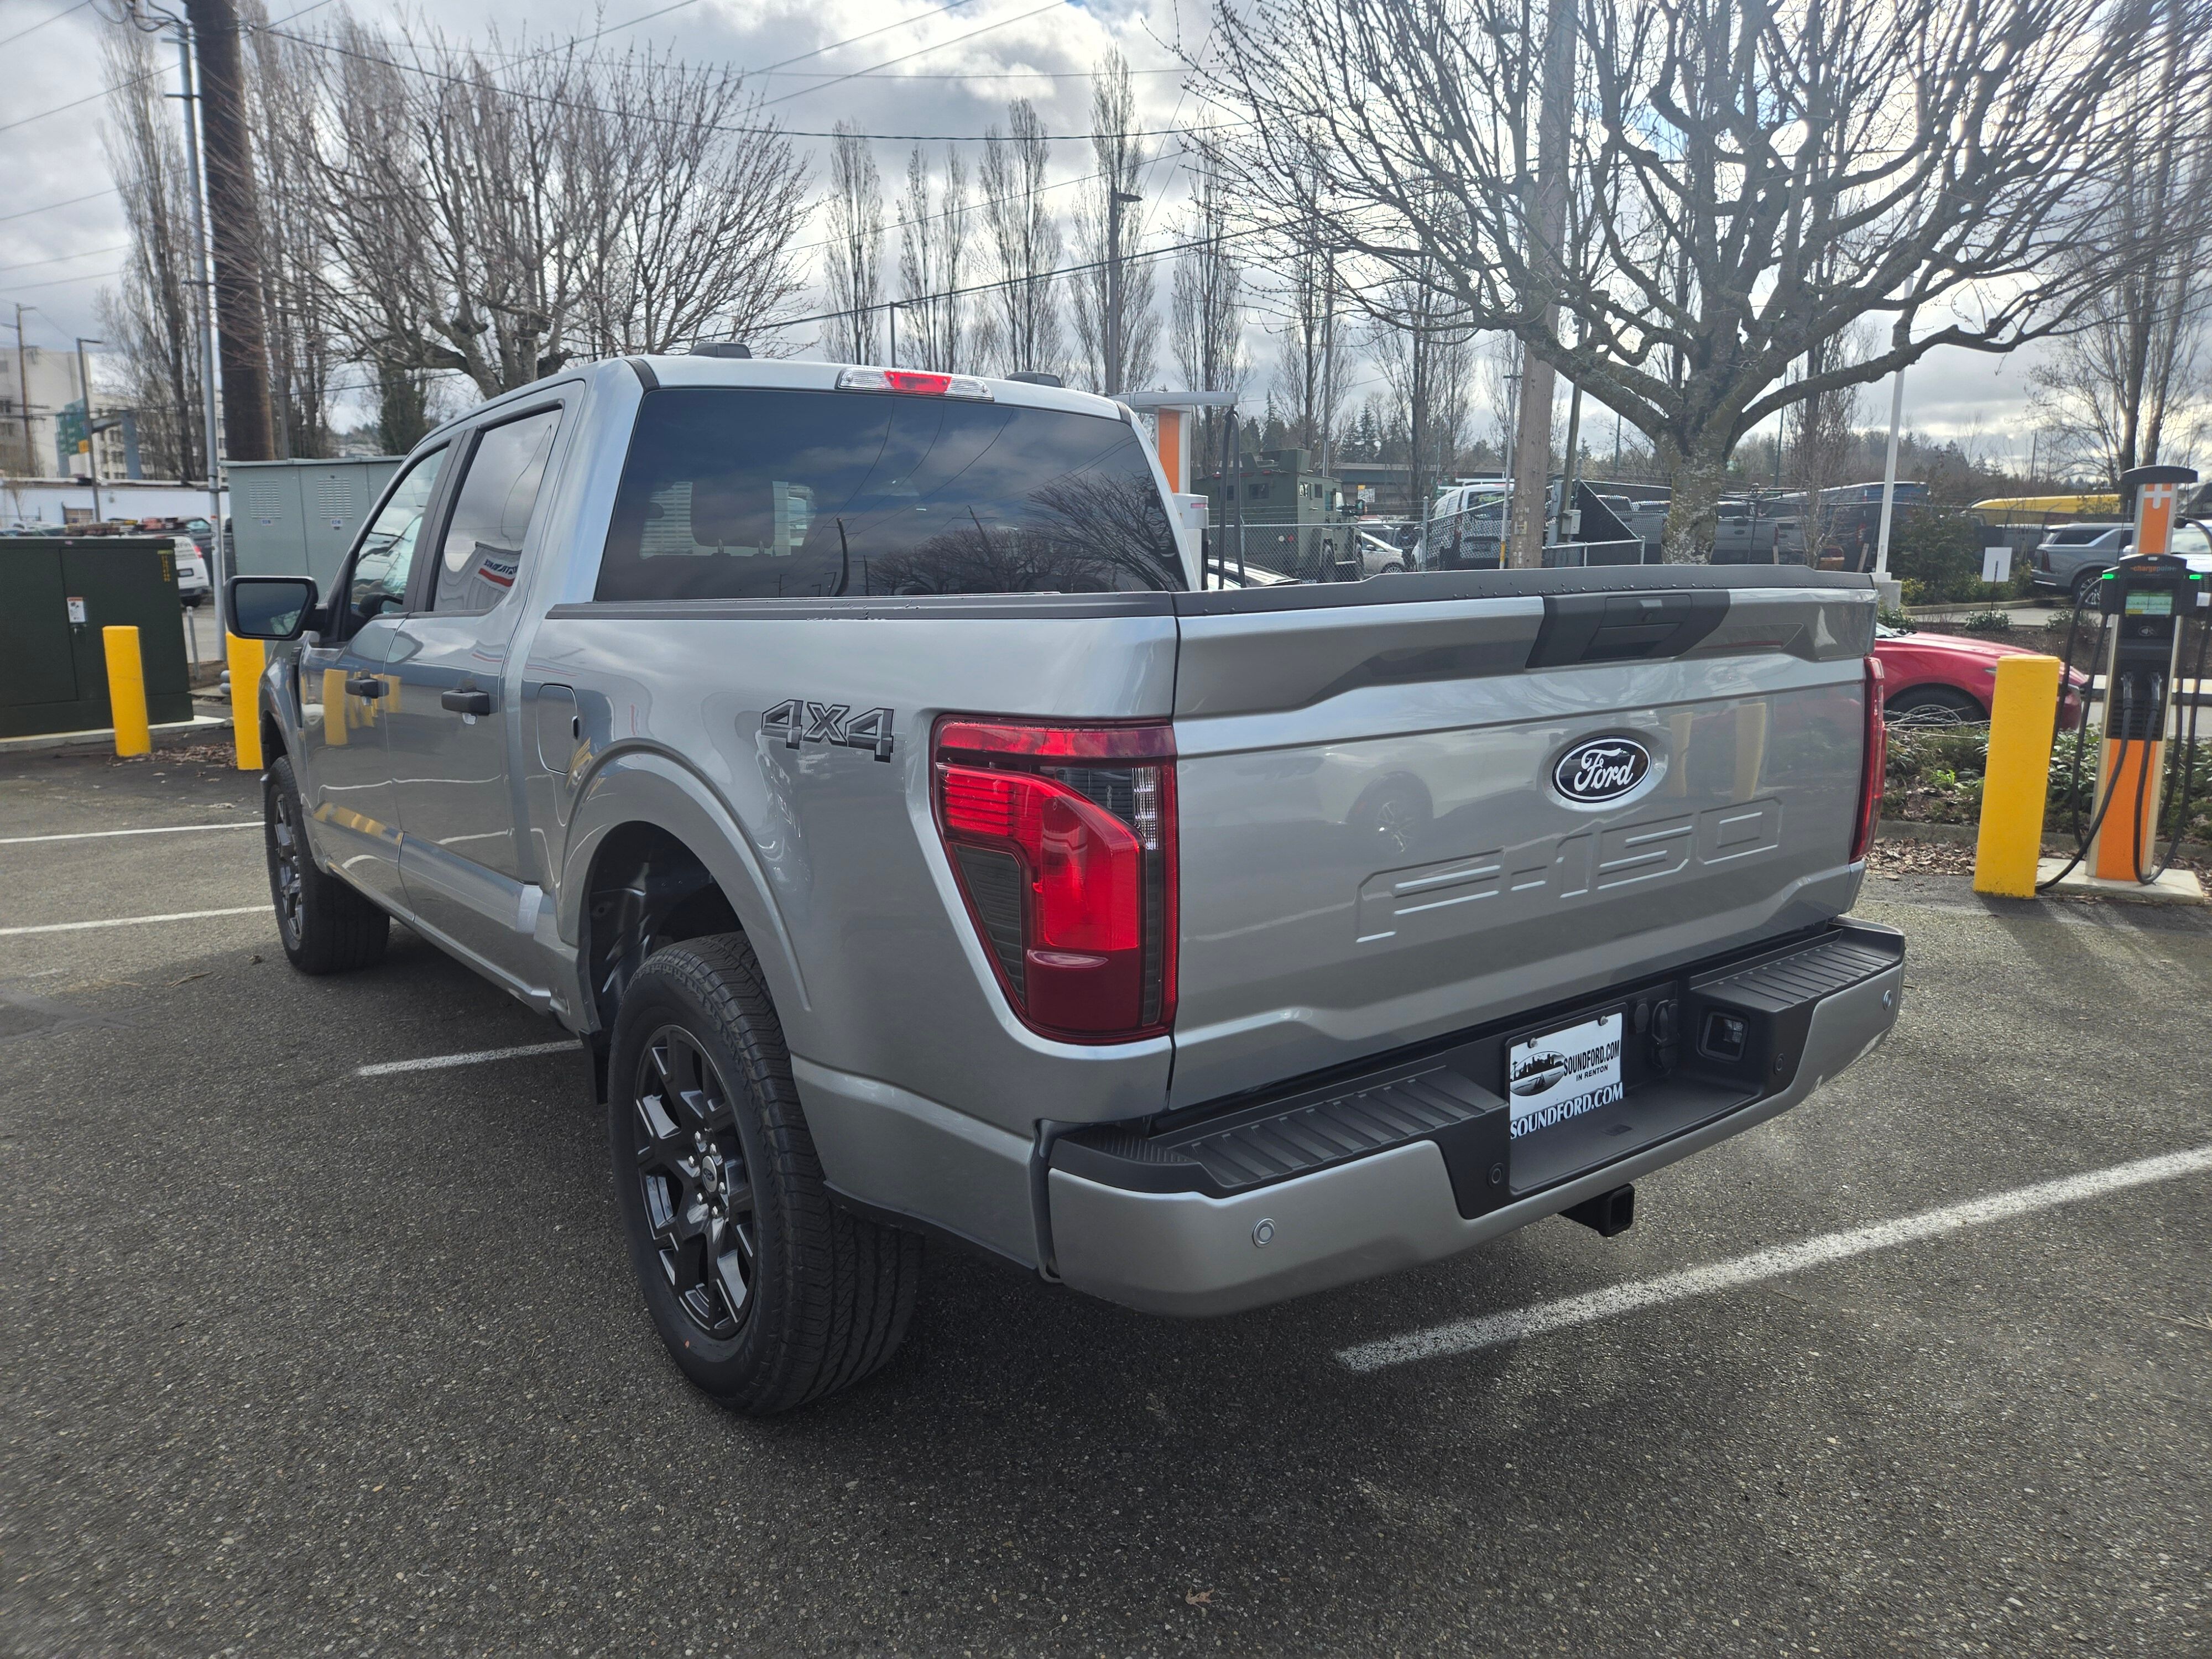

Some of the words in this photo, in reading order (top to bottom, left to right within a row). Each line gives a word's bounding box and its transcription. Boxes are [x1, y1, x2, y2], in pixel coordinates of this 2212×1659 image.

[1573, 747, 1635, 791] Ford
[1356, 797, 1783, 942] F-150
[1563, 1040, 1619, 1076] SOUNDFORD.COM
[1576, 1073, 1582, 1082] IN
[1584, 1064, 1608, 1078] RENTON
[1510, 1082, 1624, 1140] SOUNDFORD.COM
